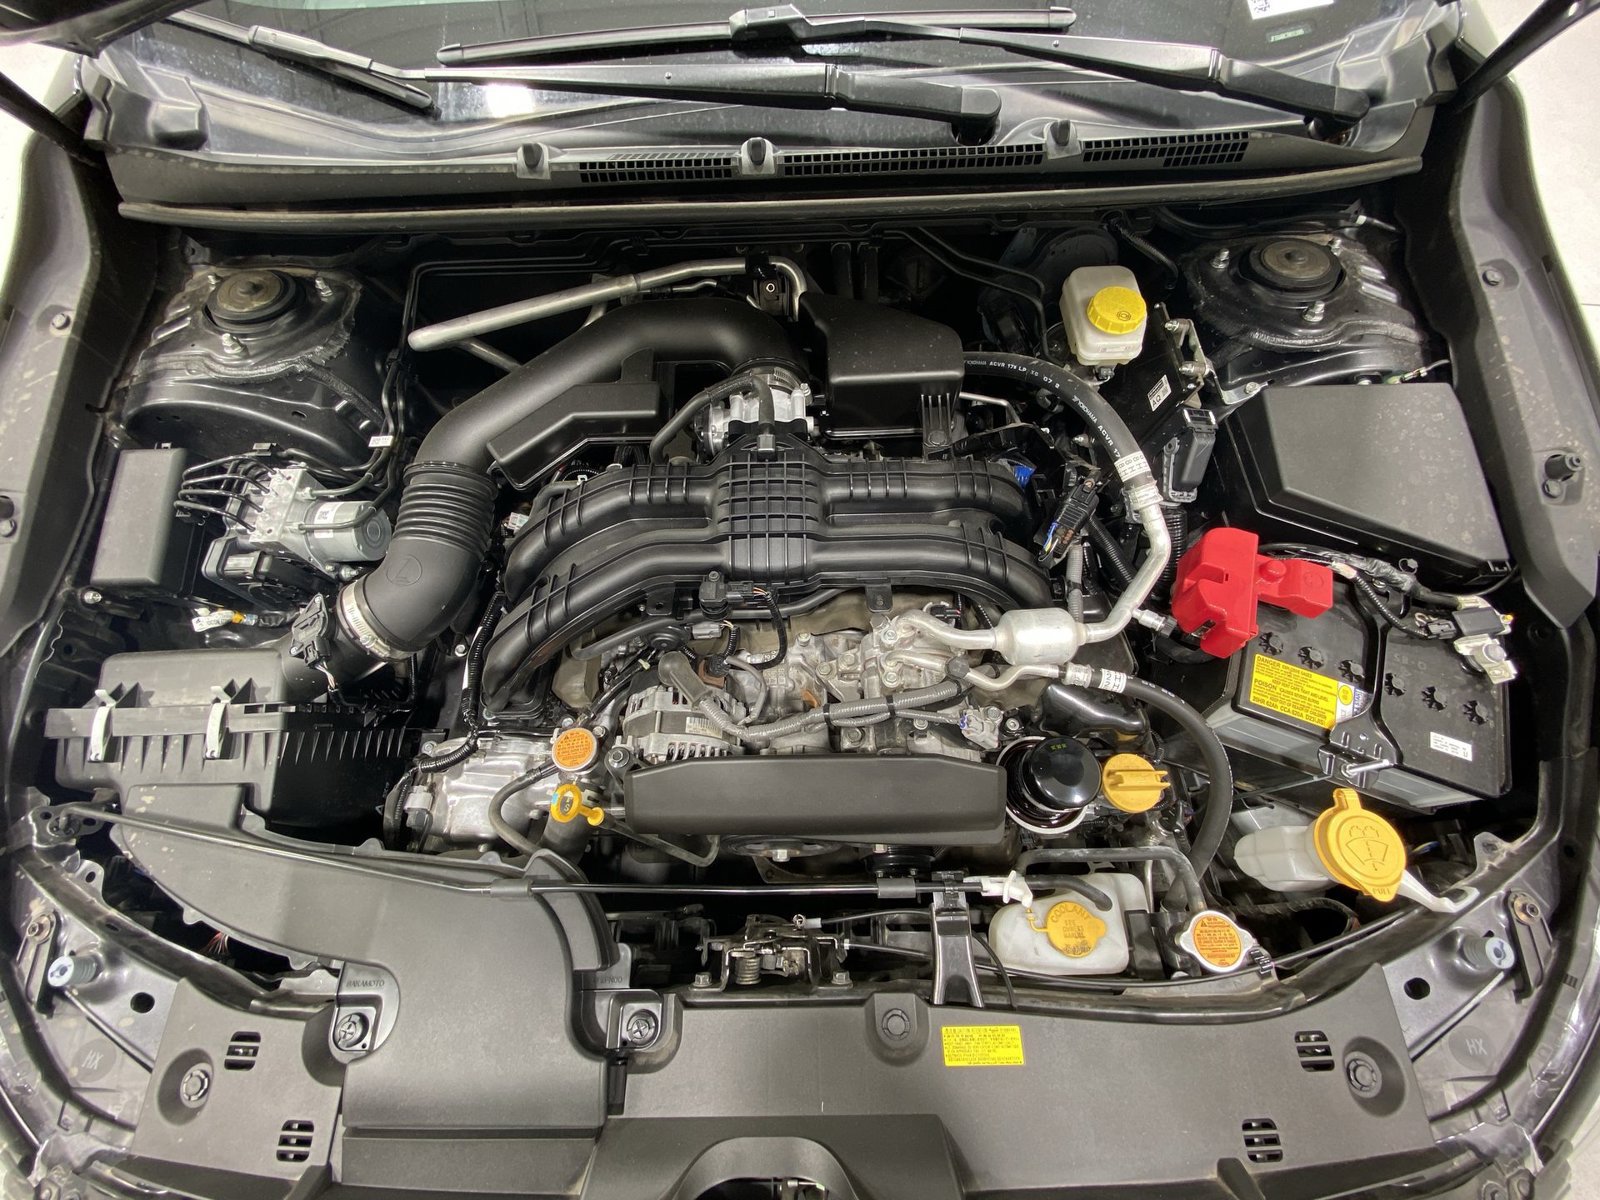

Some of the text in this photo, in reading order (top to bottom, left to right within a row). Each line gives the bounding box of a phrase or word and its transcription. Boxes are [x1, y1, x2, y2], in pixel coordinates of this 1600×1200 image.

[1098, 425, 1114, 446] ACVR
[1256, 656, 1280, 668] DANGER
[1254, 678, 1276, 691] POISON
[1280, 705, 1290, 713] CCA
[1050, 904, 1090, 922] COOLANT
